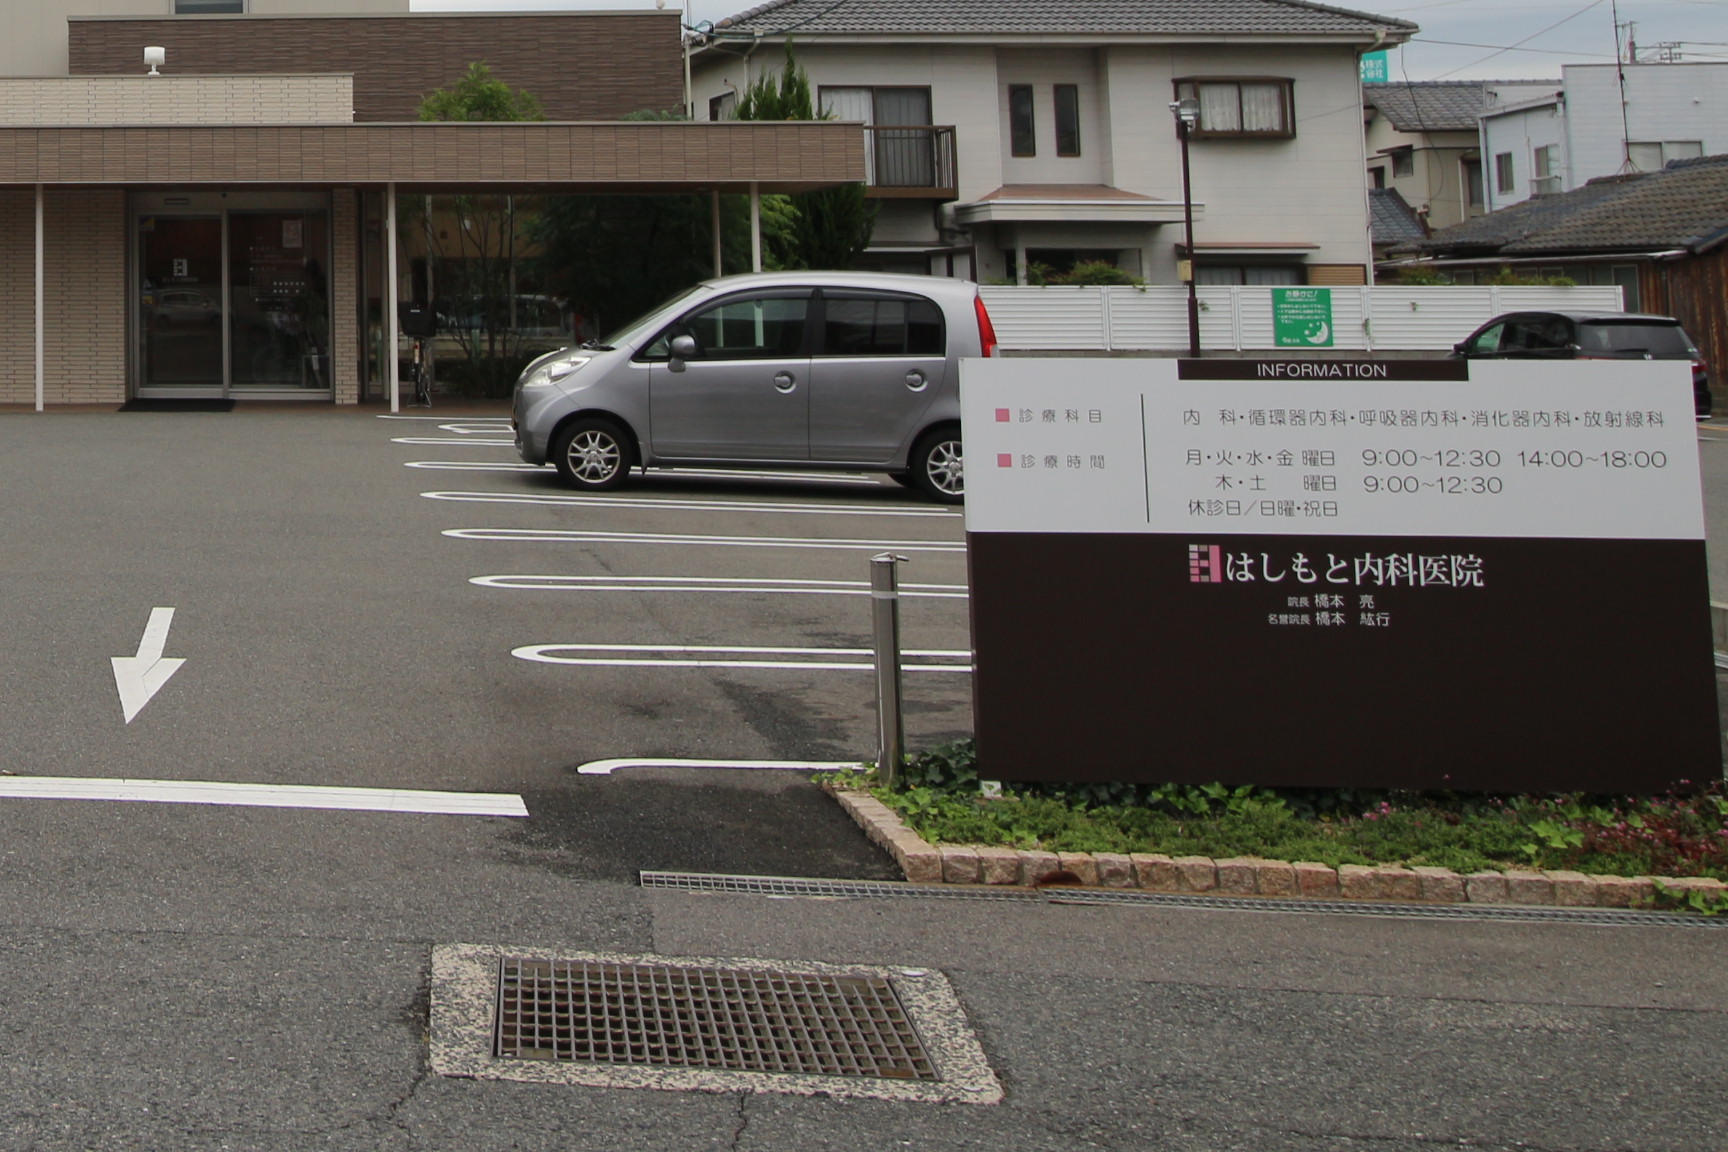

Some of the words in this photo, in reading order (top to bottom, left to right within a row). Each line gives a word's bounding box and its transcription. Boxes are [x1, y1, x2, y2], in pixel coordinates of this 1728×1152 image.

[1257, 363, 1387, 377] INFORMATION
[1018, 408, 1102, 423] 診療科目
[1021, 454, 1105, 469] 診療時間
[1226, 552, 1484, 587] はしもと内科医院
[1314, 593, 1345, 608] 橋本
[1315, 611, 1346, 626] 橋本
